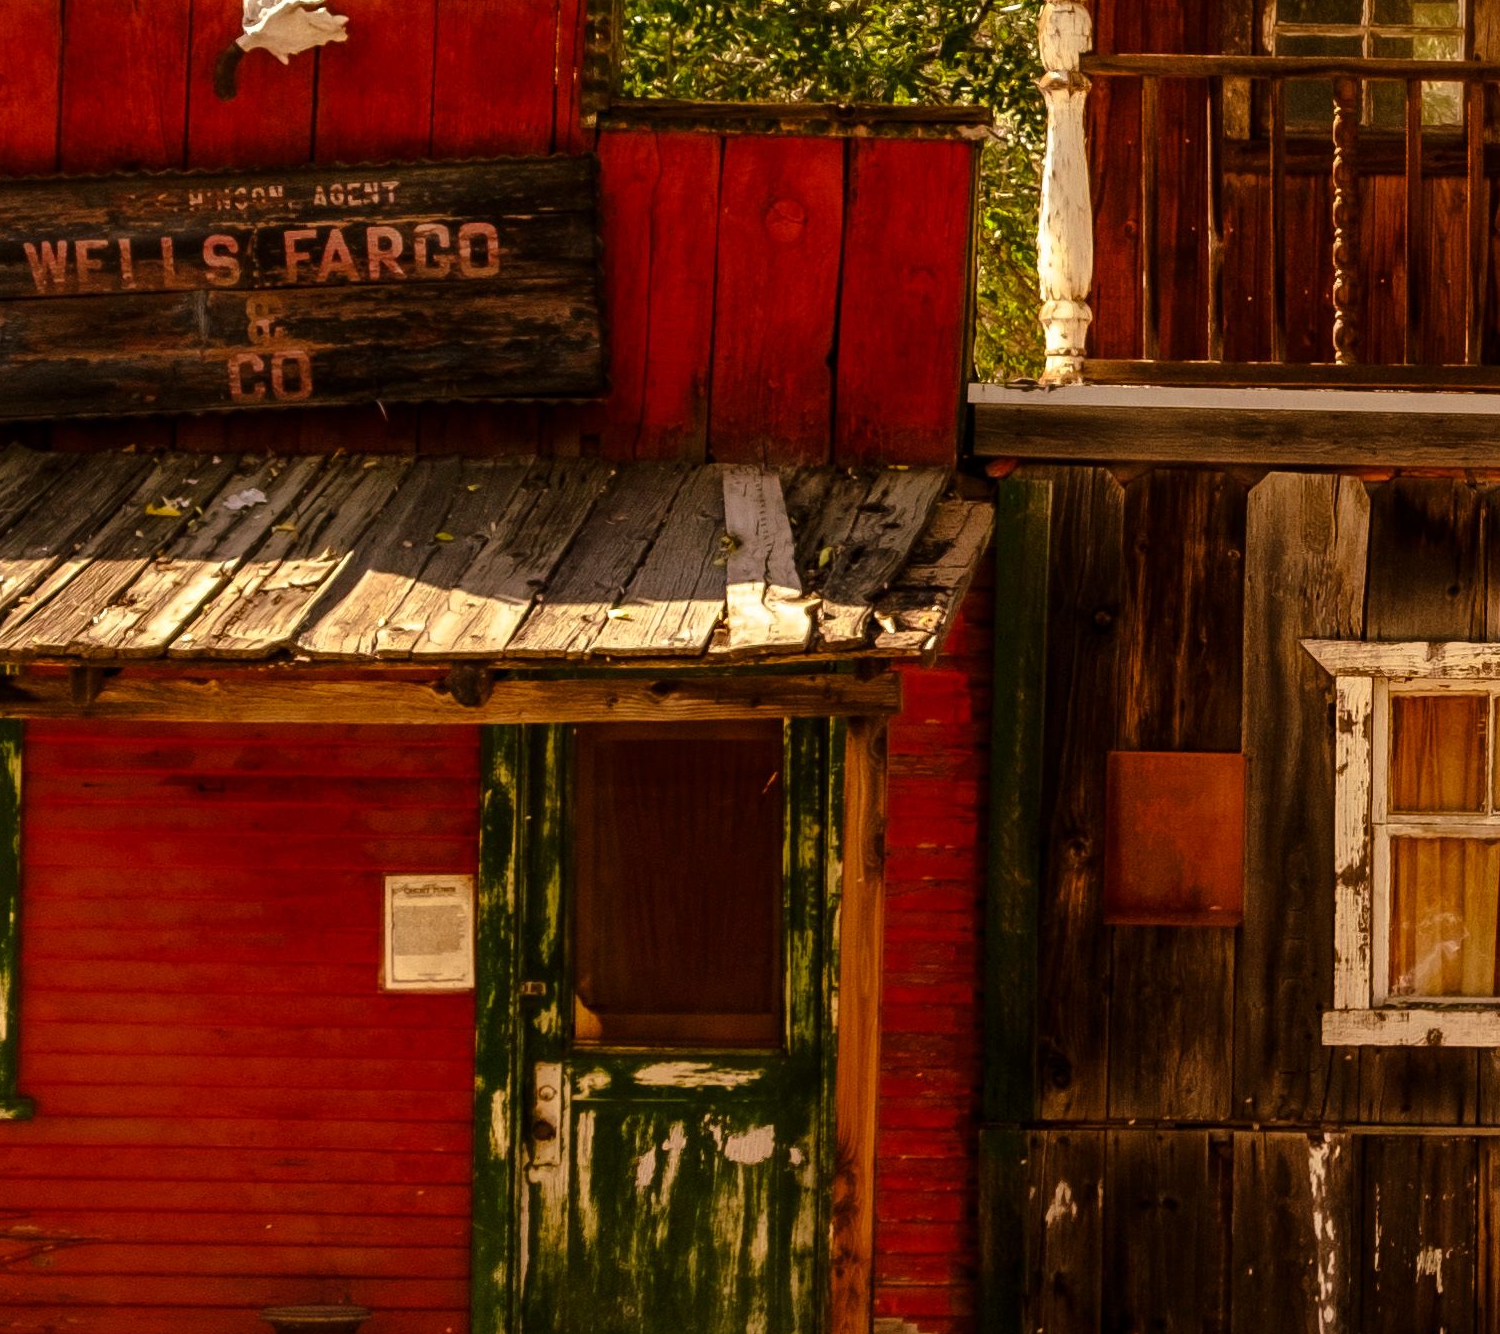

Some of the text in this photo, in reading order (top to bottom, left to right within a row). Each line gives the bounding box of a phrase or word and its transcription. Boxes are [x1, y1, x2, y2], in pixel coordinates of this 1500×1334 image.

[313, 180, 400, 207] AGENT
[23, 222, 500, 293] WELLS FARGO
[228, 350, 314, 405] CO
